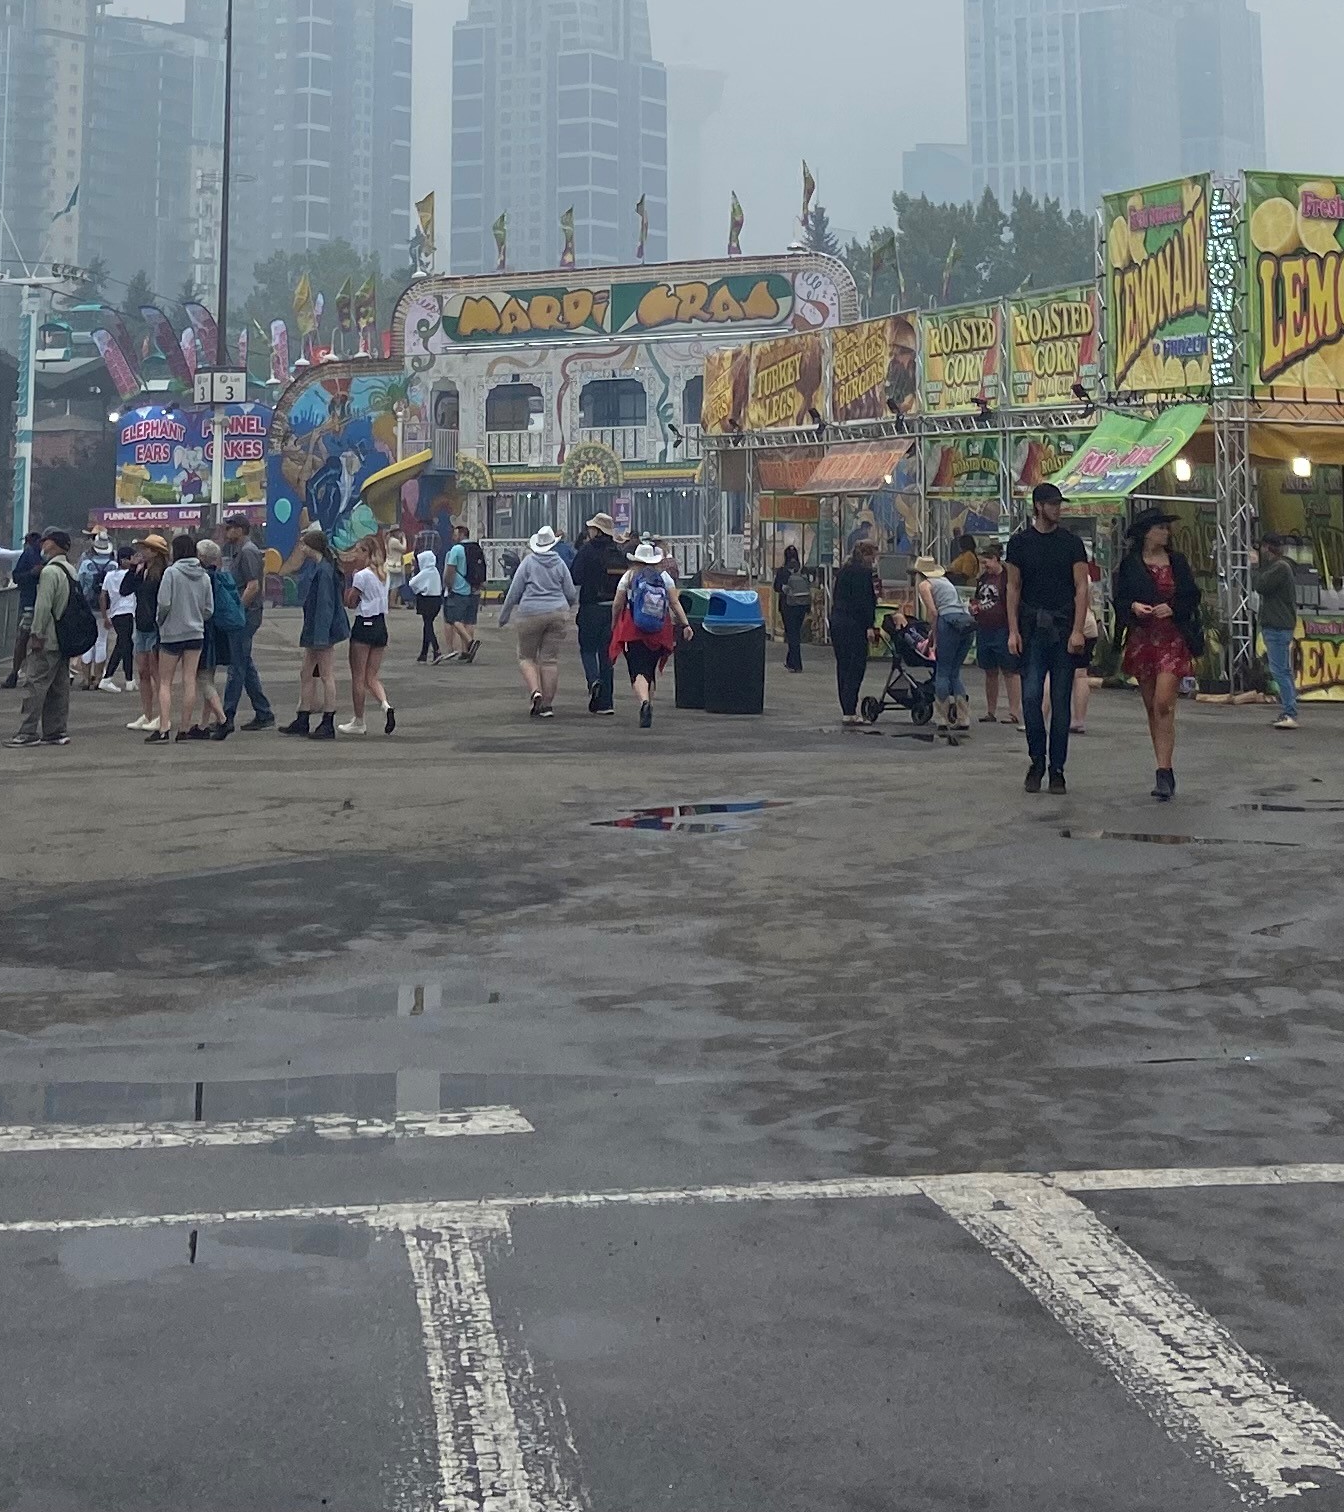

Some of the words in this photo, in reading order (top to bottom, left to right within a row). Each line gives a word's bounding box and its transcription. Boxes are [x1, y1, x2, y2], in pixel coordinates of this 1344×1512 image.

[1113, 209, 1208, 385] LEMONADE
[1207, 188, 1238, 387] LEMONADE
[929, 316, 997, 357] ROASTED
[1013, 300, 1094, 345] ROASTED
[756, 352, 803, 399] TURKEY
[944, 352, 986, 387] CORN
[1033, 340, 1080, 378] CORN
[224, 385, 234, 400] 3
[765, 391, 795, 426] LEGS
[121, 418, 186, 445] ELEPHANT
[202, 414, 267, 438] FNNEL
[135, 443, 171, 463] EARS
[103, 512, 137, 521] FUNNEL
[138, 511, 169, 520] CAKES
